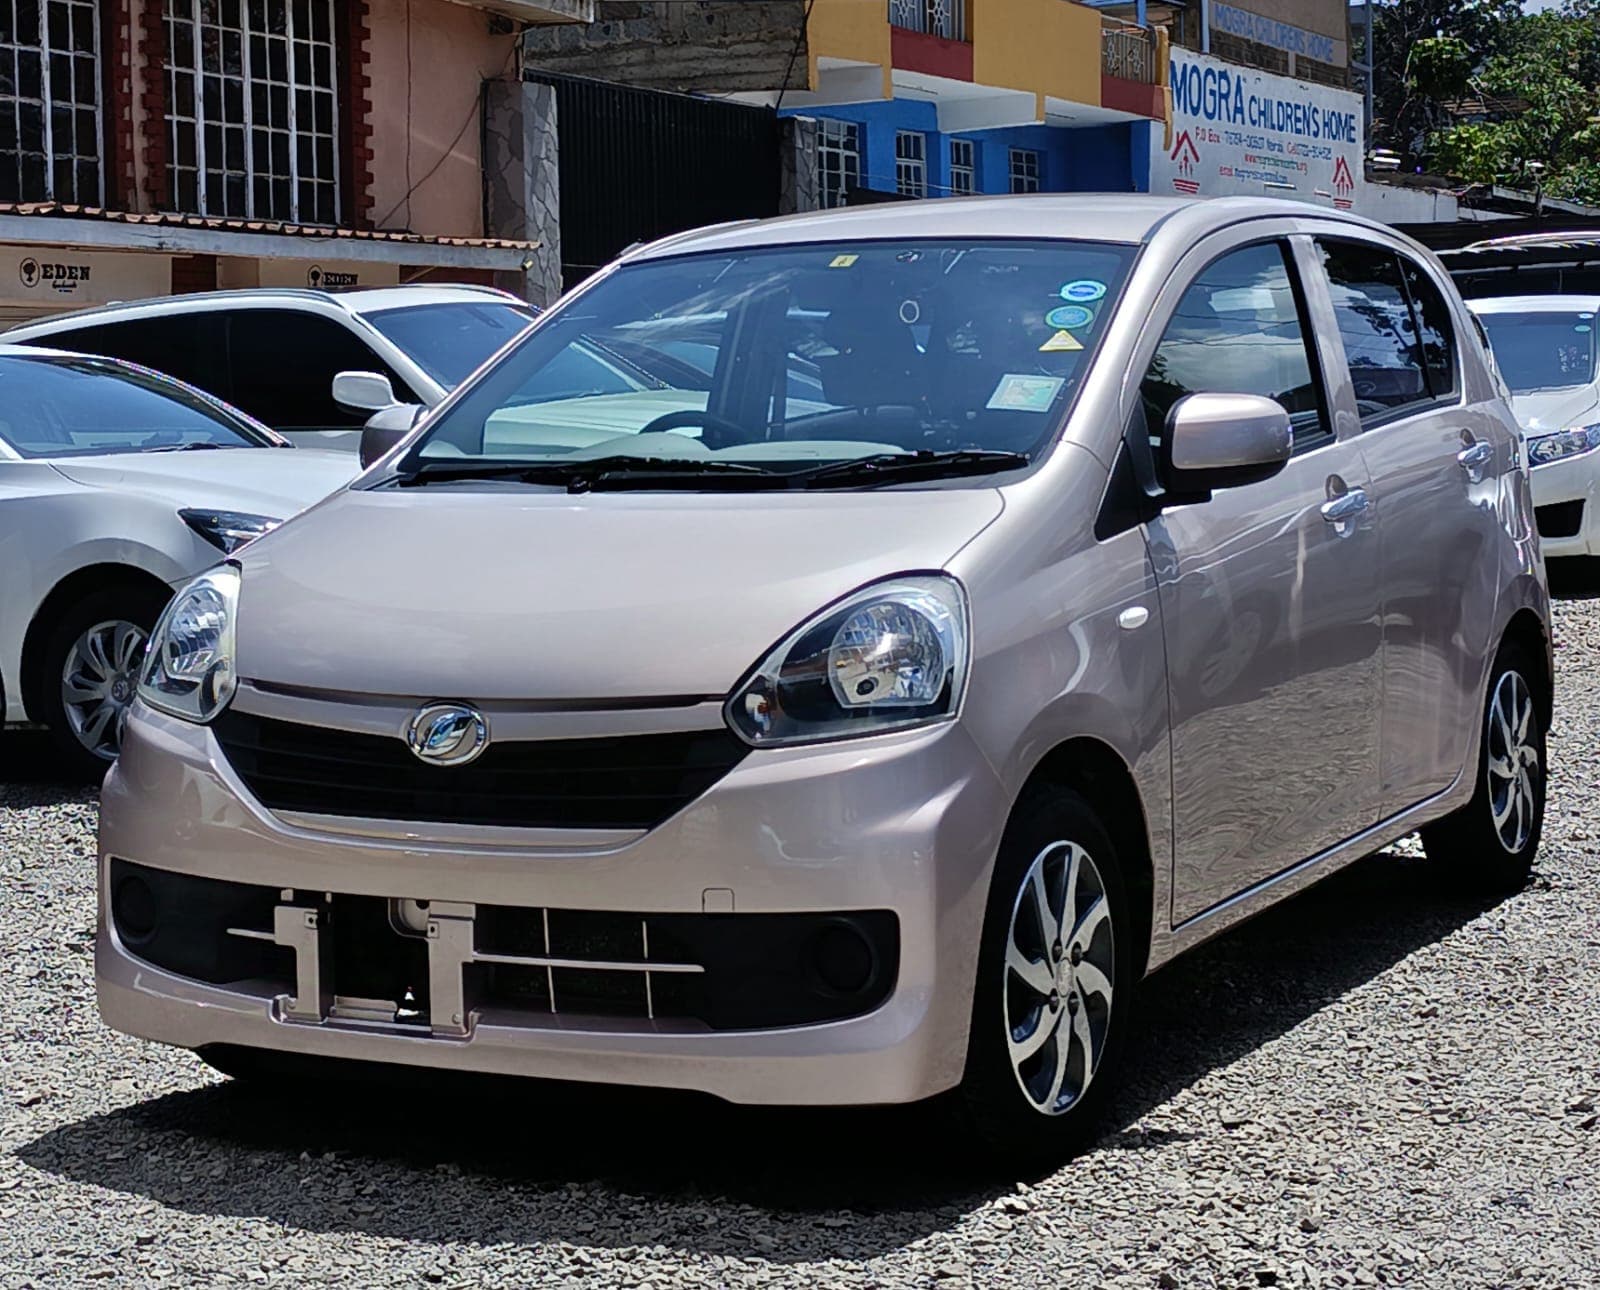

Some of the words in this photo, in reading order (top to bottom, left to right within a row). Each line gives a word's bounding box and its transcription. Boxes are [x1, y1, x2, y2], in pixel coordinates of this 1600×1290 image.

[1170, 60, 1246, 126] MOGRA
[1249, 94, 1320, 139] CHILDREN'S
[1322, 108, 1357, 144] HOME
[41, 264, 91, 281] EDEN
